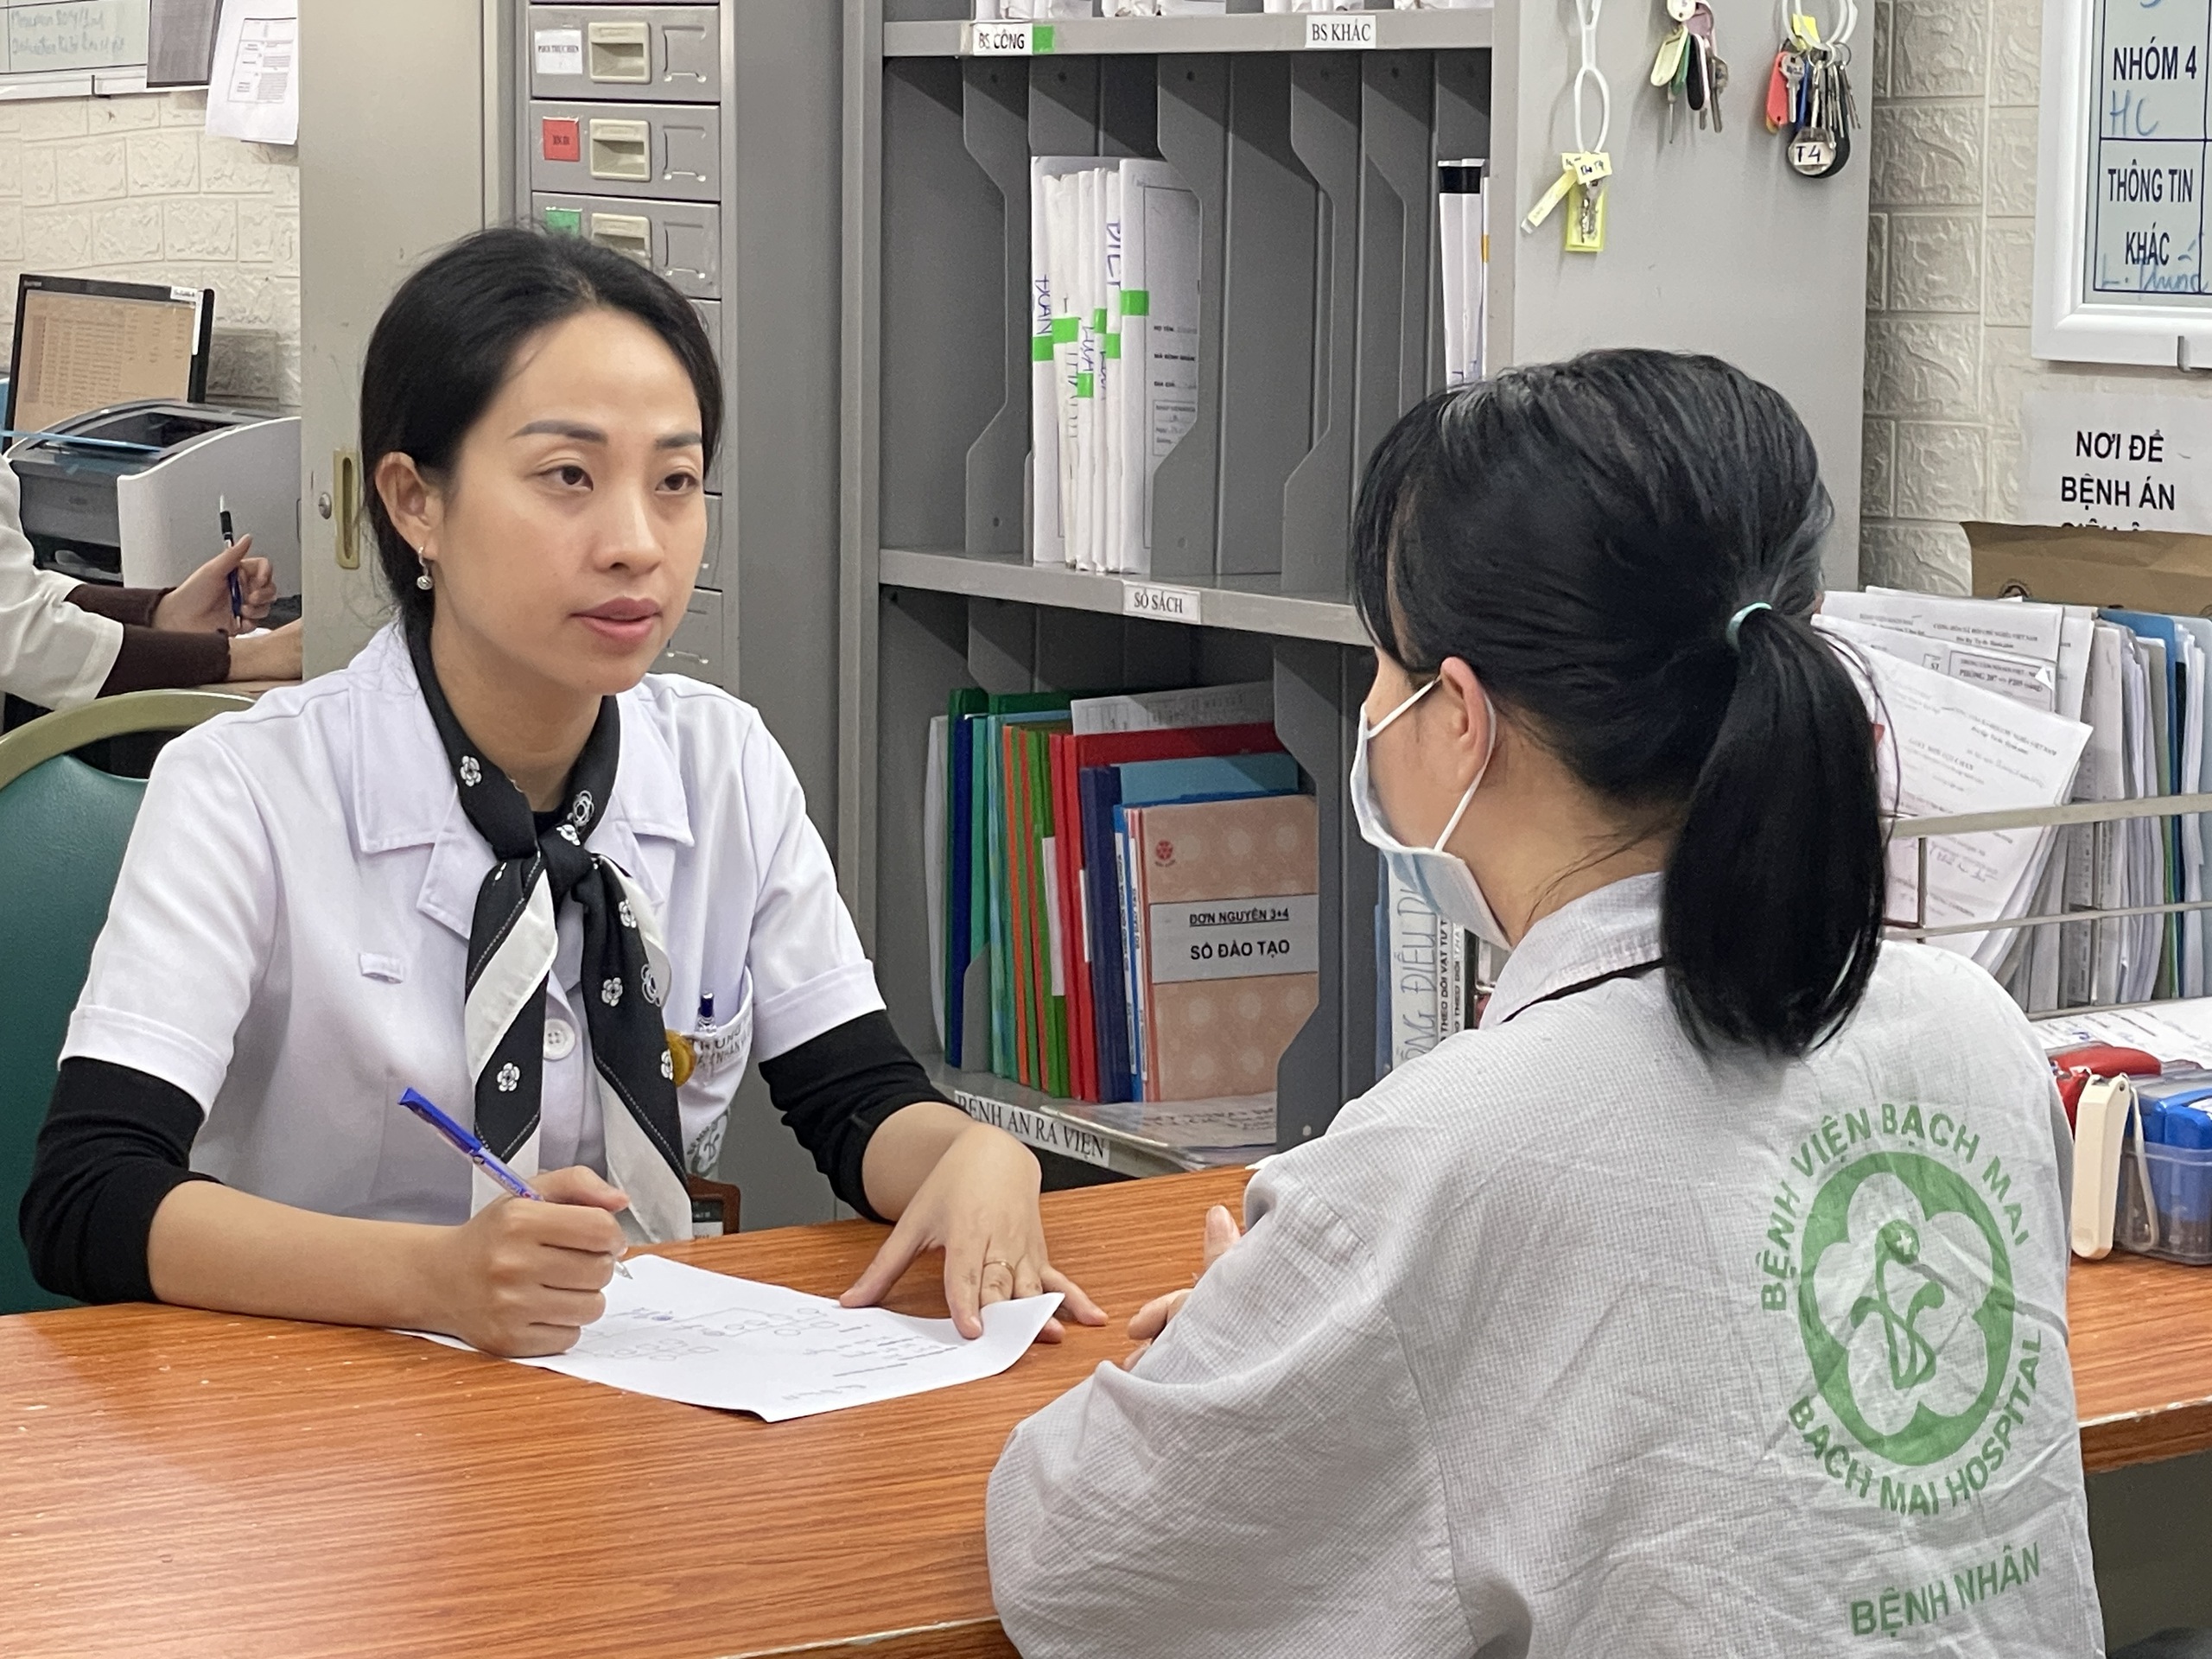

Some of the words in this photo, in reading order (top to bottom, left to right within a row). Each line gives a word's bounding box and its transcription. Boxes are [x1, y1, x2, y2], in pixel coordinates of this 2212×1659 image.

[978, 32, 990, 48] BS
[994, 29, 1025, 49] CÔNG
[1312, 23, 1328, 41] BS
[1332, 18, 1371, 41] KHÁC
[2113, 36, 2178, 80] NHÓM
[2185, 46, 2197, 79] 4
[1796, 144, 1821, 163] T4
[2107, 158, 2163, 202] THÔNG
[2168, 168, 2194, 202] TIN
[2126, 221, 2170, 265] KHÁC
[2076, 431, 2120, 459] NƠI
[2129, 429, 2164, 462] ĐỂ
[2062, 473, 2130, 510] BỆNH
[2139, 476, 2174, 510] ÁN
[1152, 591, 1183, 613] SÁCH
[1189, 913, 1216, 925] ĐƠN
[1219, 908, 1268, 924] NGUYÊN
[1270, 908, 1289, 920] 3+4
[1217, 938, 1253, 957] ĐÀO
[1257, 939, 1290, 958] TẠO
[1036, 1117, 1058, 1145] RA
[1756, 1180, 1800, 1311] BỆNH
[1791, 1108, 1872, 1177] VIỆN
[1882, 1103, 1980, 1164] BẠCH
[1981, 1155, 2029, 1246] MAI
[1789, 1395, 1872, 1498] BACH
[1880, 1476, 1939, 1516] MAI
[1946, 1329, 2041, 1507] HOSPITAL
[1850, 1580, 1949, 1637] BỆNH
[1954, 1542, 2039, 1610] NHÂN
